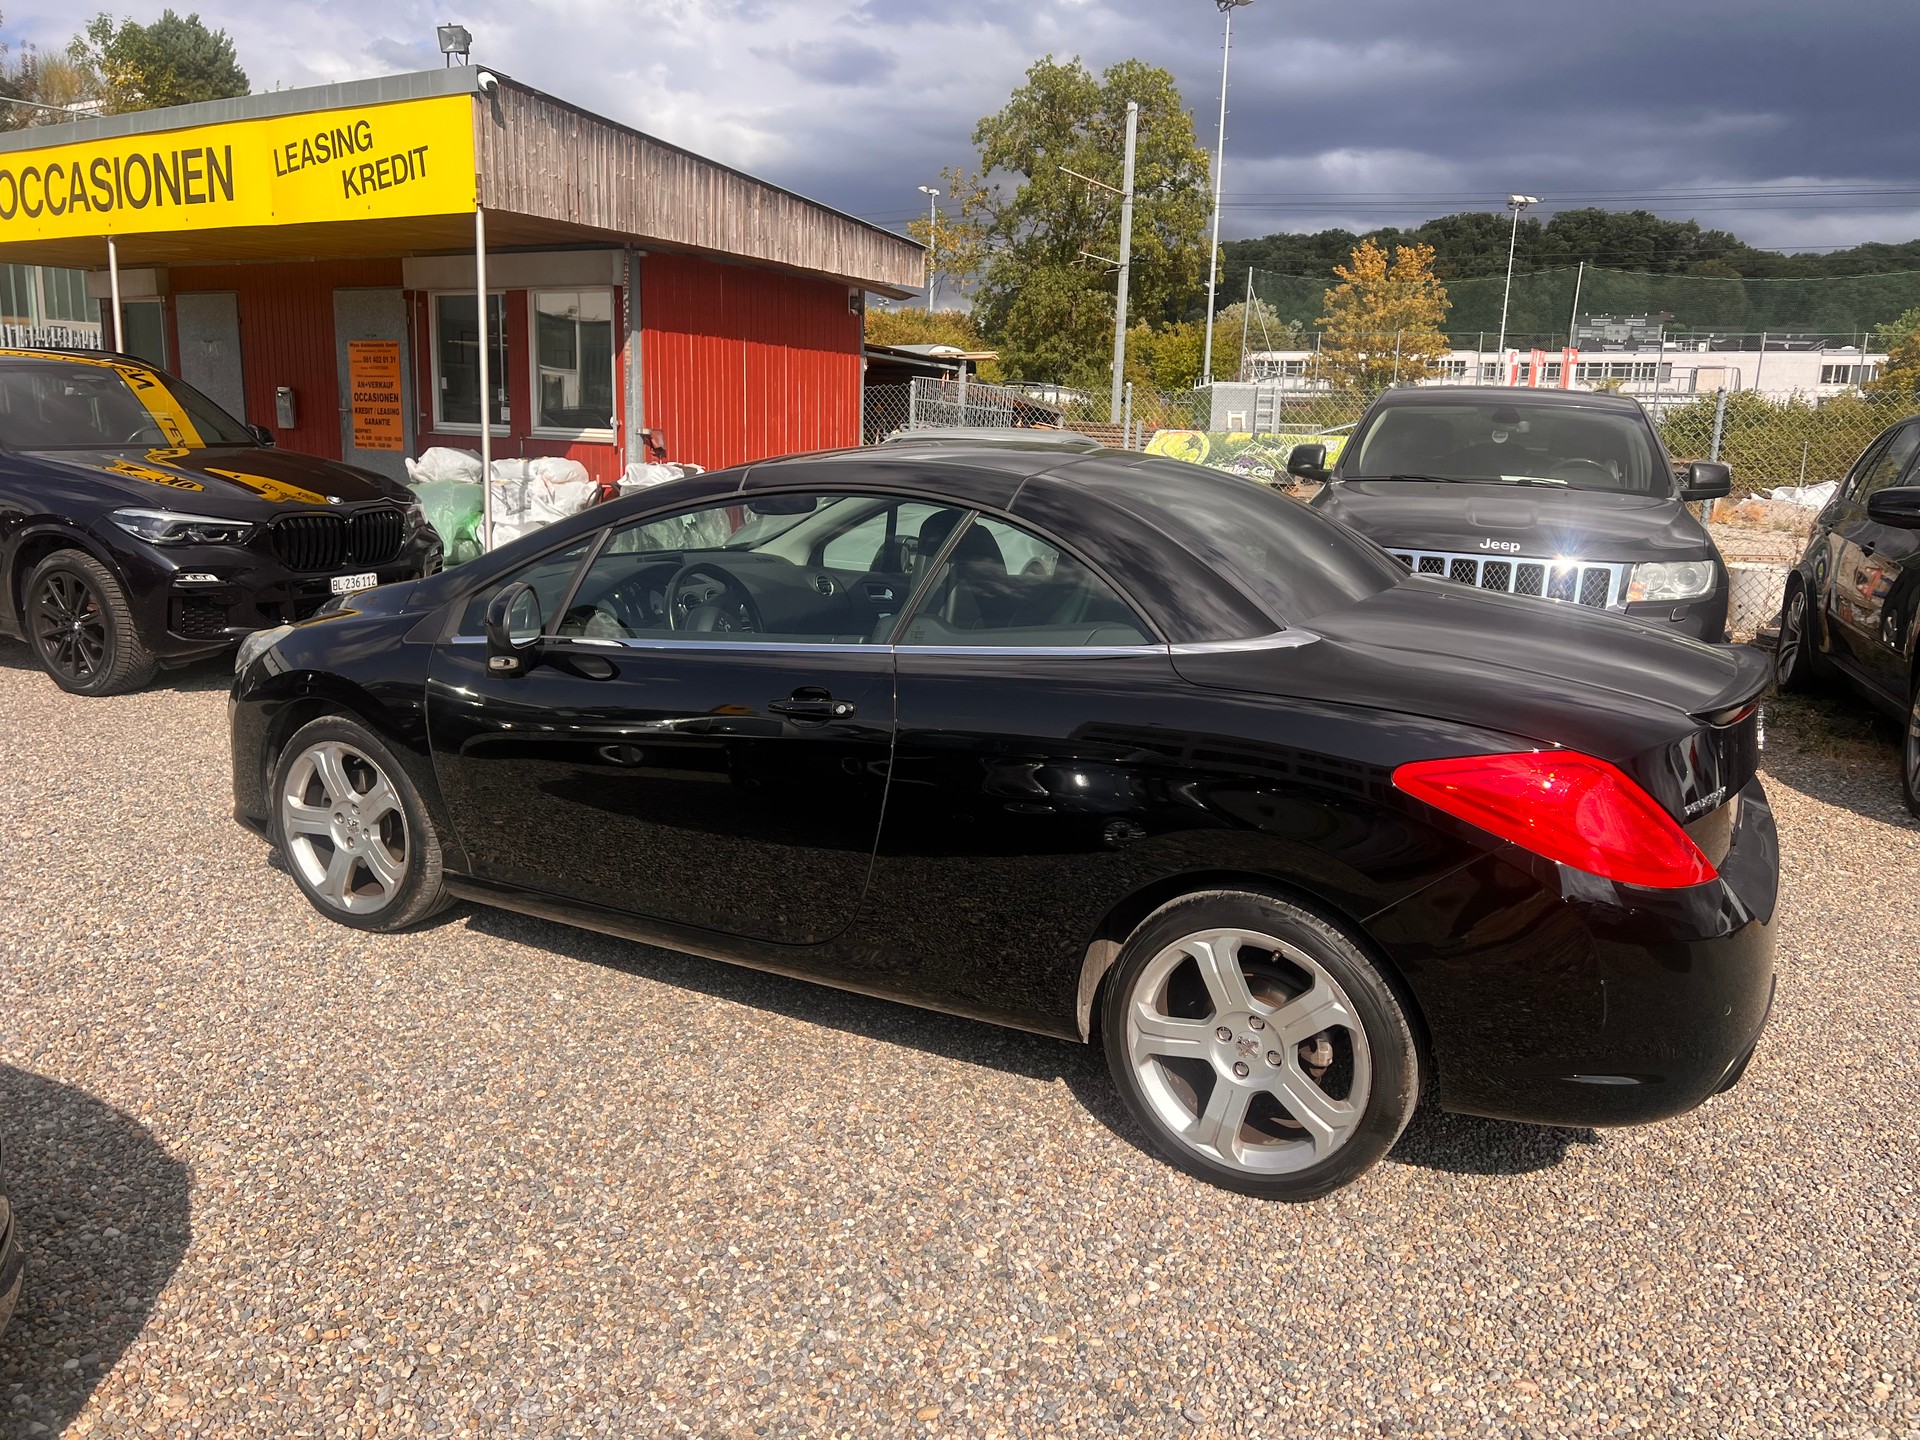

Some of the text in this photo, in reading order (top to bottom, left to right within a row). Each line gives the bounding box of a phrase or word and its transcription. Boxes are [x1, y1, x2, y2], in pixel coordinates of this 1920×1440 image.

[273, 119, 374, 177] LEASING
[342, 145, 429, 199] KREDIT
[0, 145, 234, 220] OCCASIONEN
[357, 381, 394, 389] AN+VERKAUF
[354, 392, 399, 403] OCCASIONEN
[354, 407, 373, 415] KREDIT
[377, 408, 400, 416] LEASING
[364, 417, 391, 426] GARANTIE
[1480, 538, 1520, 553] Jeep
